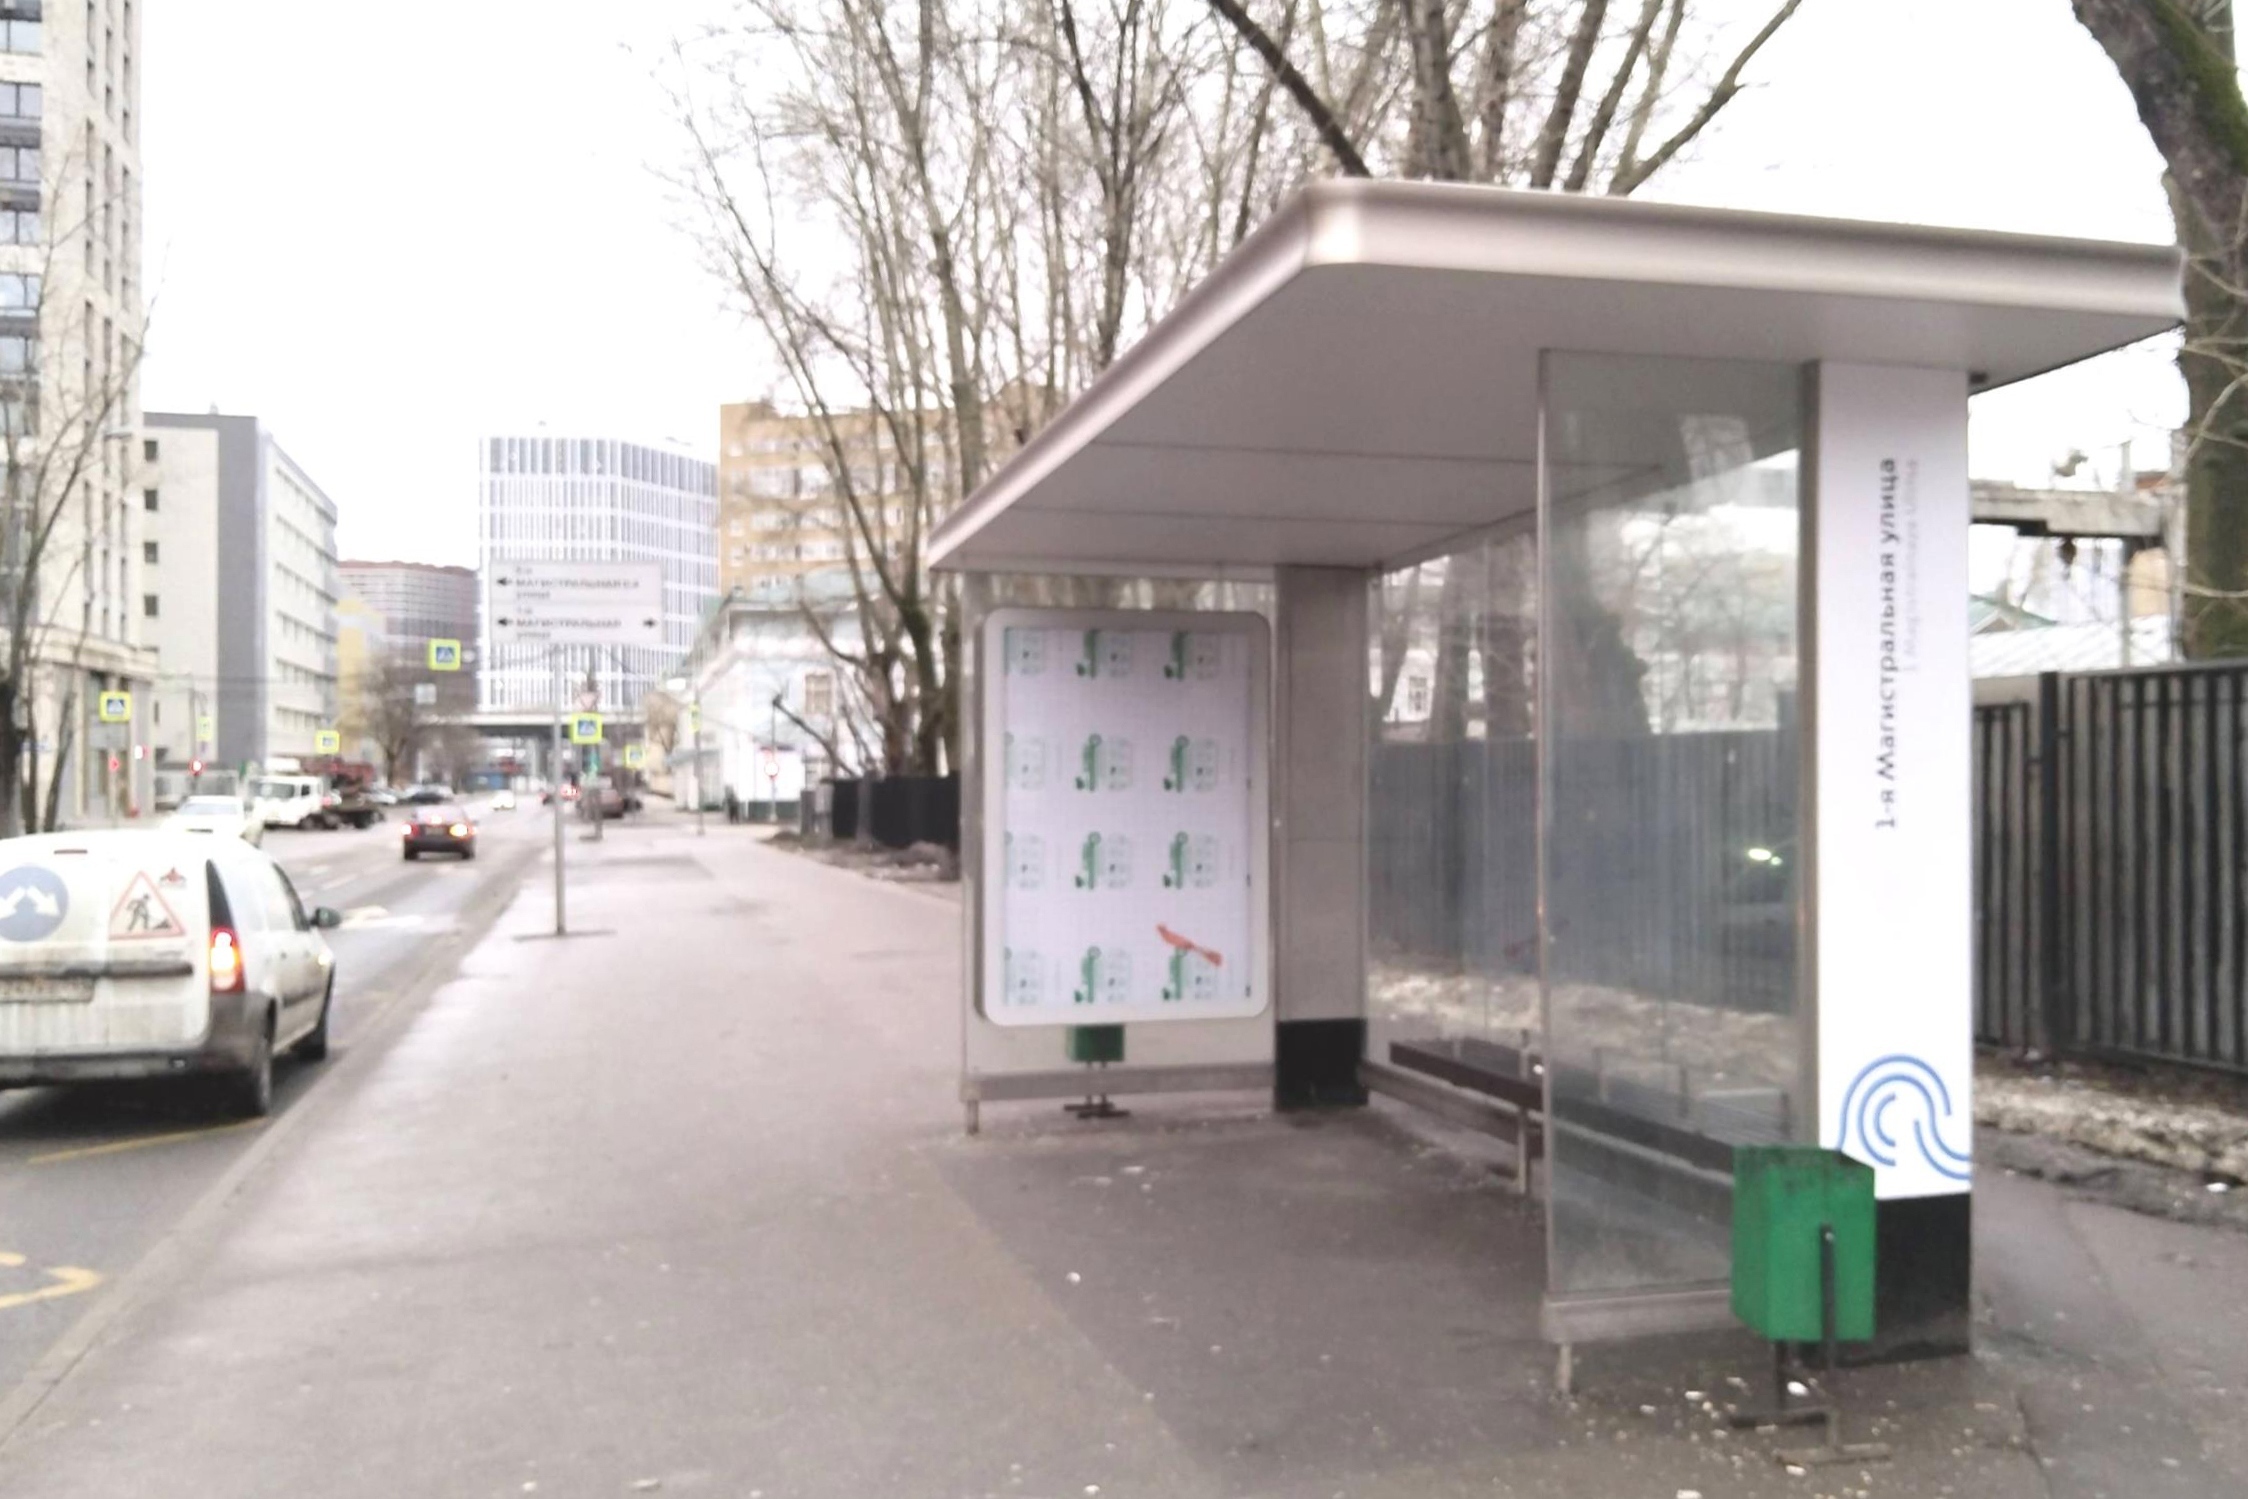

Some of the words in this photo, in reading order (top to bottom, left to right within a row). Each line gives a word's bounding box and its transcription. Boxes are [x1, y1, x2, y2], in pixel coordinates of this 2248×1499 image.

[1878, 457, 1900, 544] улица
[1875, 551, 1899, 781] Магистральная
[1874, 788, 1897, 830] 1-я
